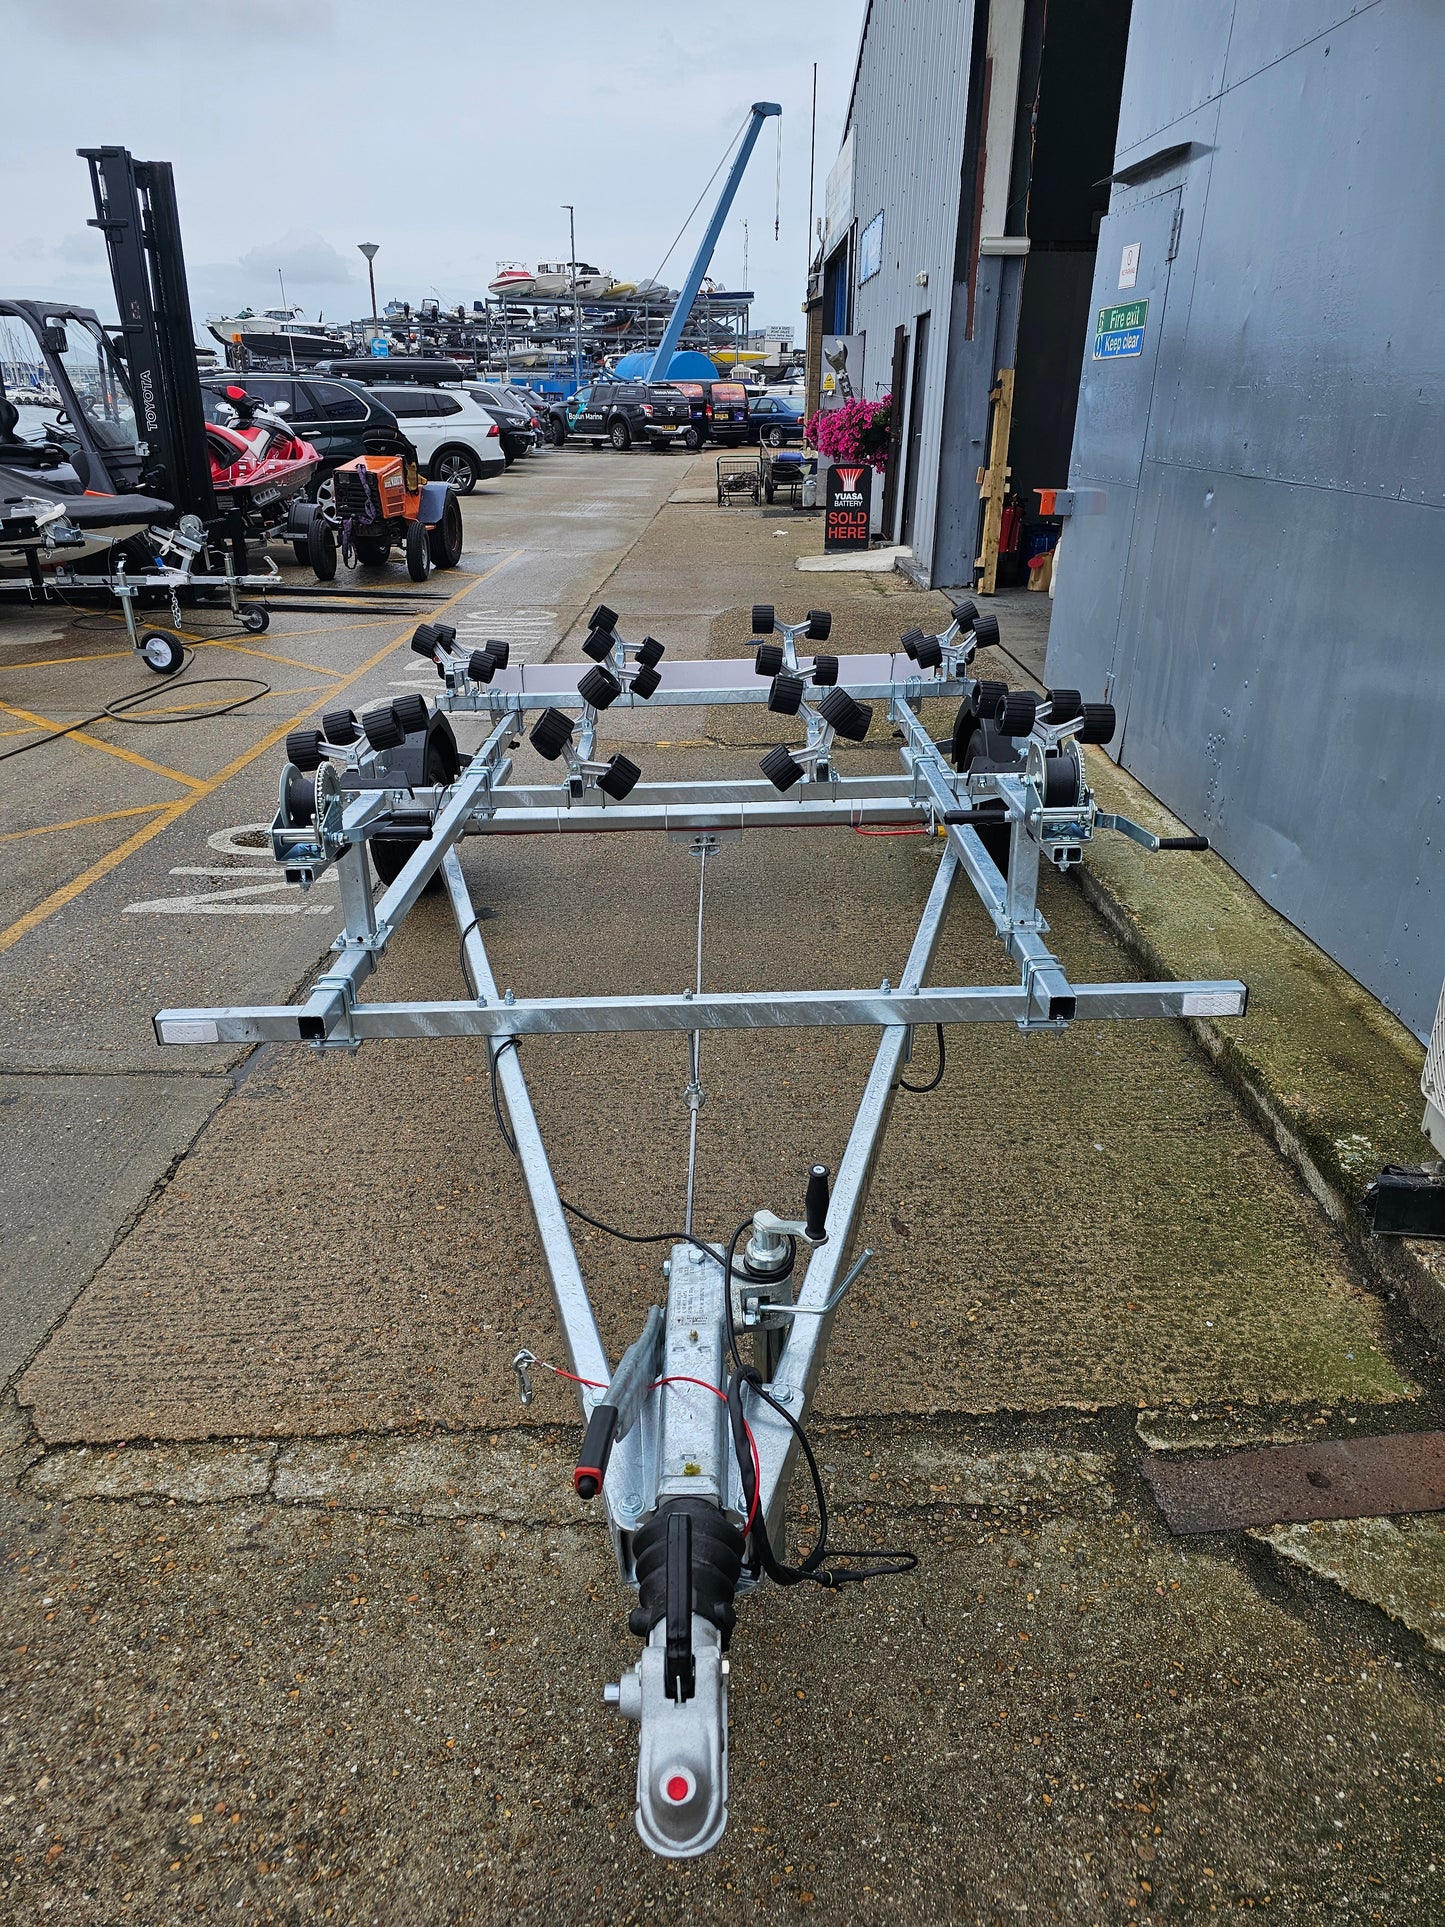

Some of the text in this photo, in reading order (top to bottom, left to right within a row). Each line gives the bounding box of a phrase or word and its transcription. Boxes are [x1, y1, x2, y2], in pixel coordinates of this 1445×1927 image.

[1109, 306, 1140, 330] Fire exit
[1104, 332, 1140, 354] Keep clear
[140, 369, 158, 431] TOYOTA
[568, 412, 603, 420] Bosun Marine
[828, 512, 867, 525] SOLD
[828, 526, 867, 539] HERE
